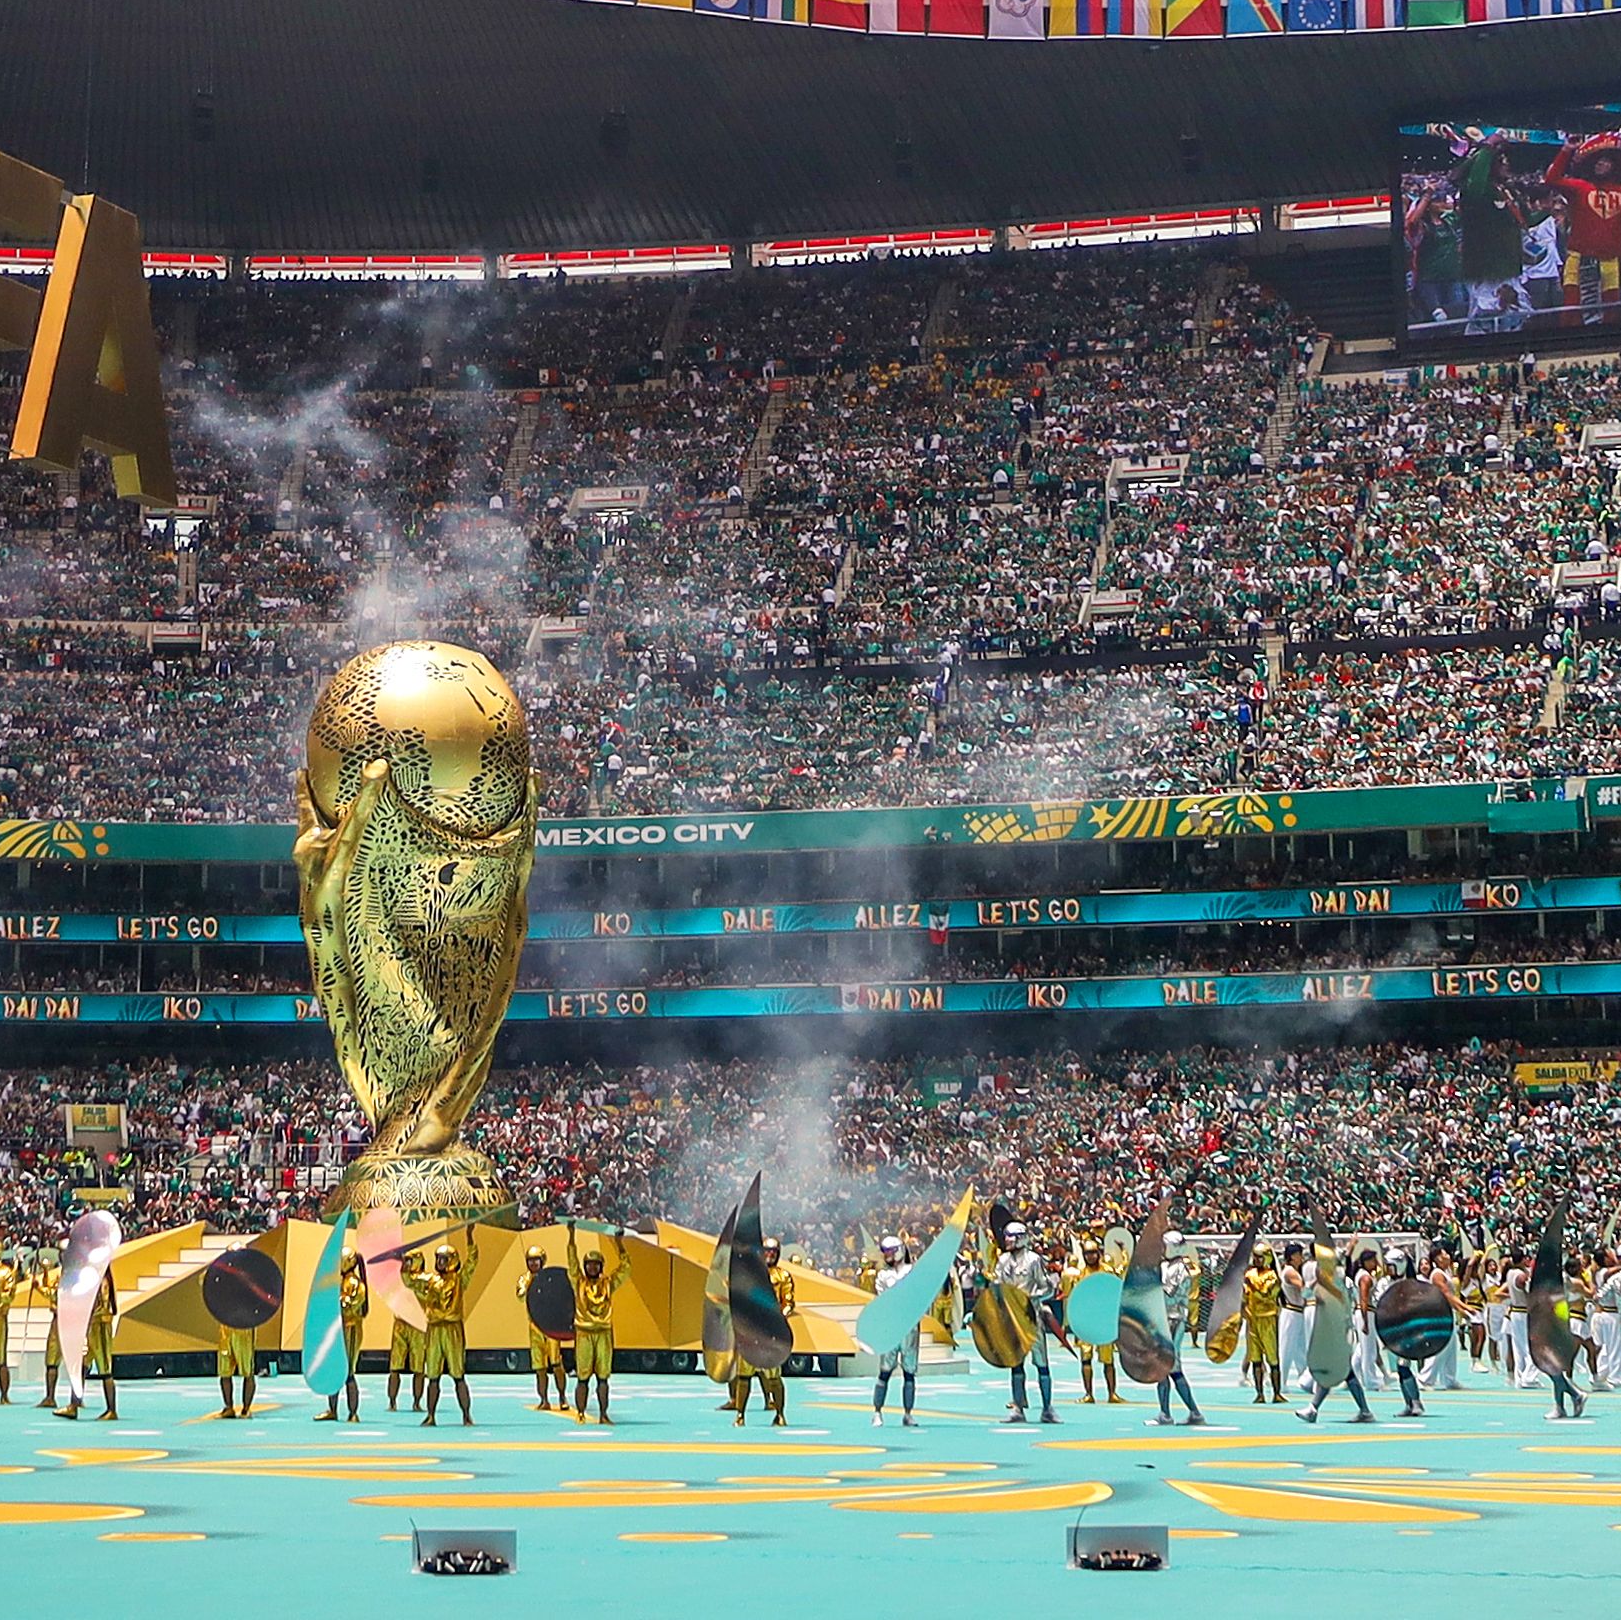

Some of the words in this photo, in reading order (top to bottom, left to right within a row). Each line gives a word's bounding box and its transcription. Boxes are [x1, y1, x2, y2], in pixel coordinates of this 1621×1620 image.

[535, 825, 667, 847] MEXICO
[673, 822, 755, 842] CITY
[1310, 890, 1346, 915] DAI
[1354, 887, 1390, 913] DAI
[1485, 883, 1520, 909] KO
[593, 911, 630, 936] IKO
[723, 908, 774, 932] DALE
[854, 903, 921, 929] ALLEZ
[977, 898, 1040, 925] LET'S
[1048, 897, 1080, 923] GO
[117, 916, 179, 940] LET'S
[187, 916, 219, 939] GO
[1163, 980, 1217, 1005] DALE
[1303, 975, 1372, 1002] ALLEZ
[1432, 969, 1498, 997] LET'S
[1507, 967, 1541, 993] GO
[3, 995, 37, 1020] DAI
[45, 996, 79, 1020] DAI
[547, 992, 608, 1018] LET'S
[616, 991, 646, 1016] GO
[868, 986, 901, 1012] DAI
[909, 985, 944, 1010] DAI
[1028, 983, 1067, 1007] IKO
[163, 996, 201, 1020] IKO
[296, 998, 324, 1020] DA
